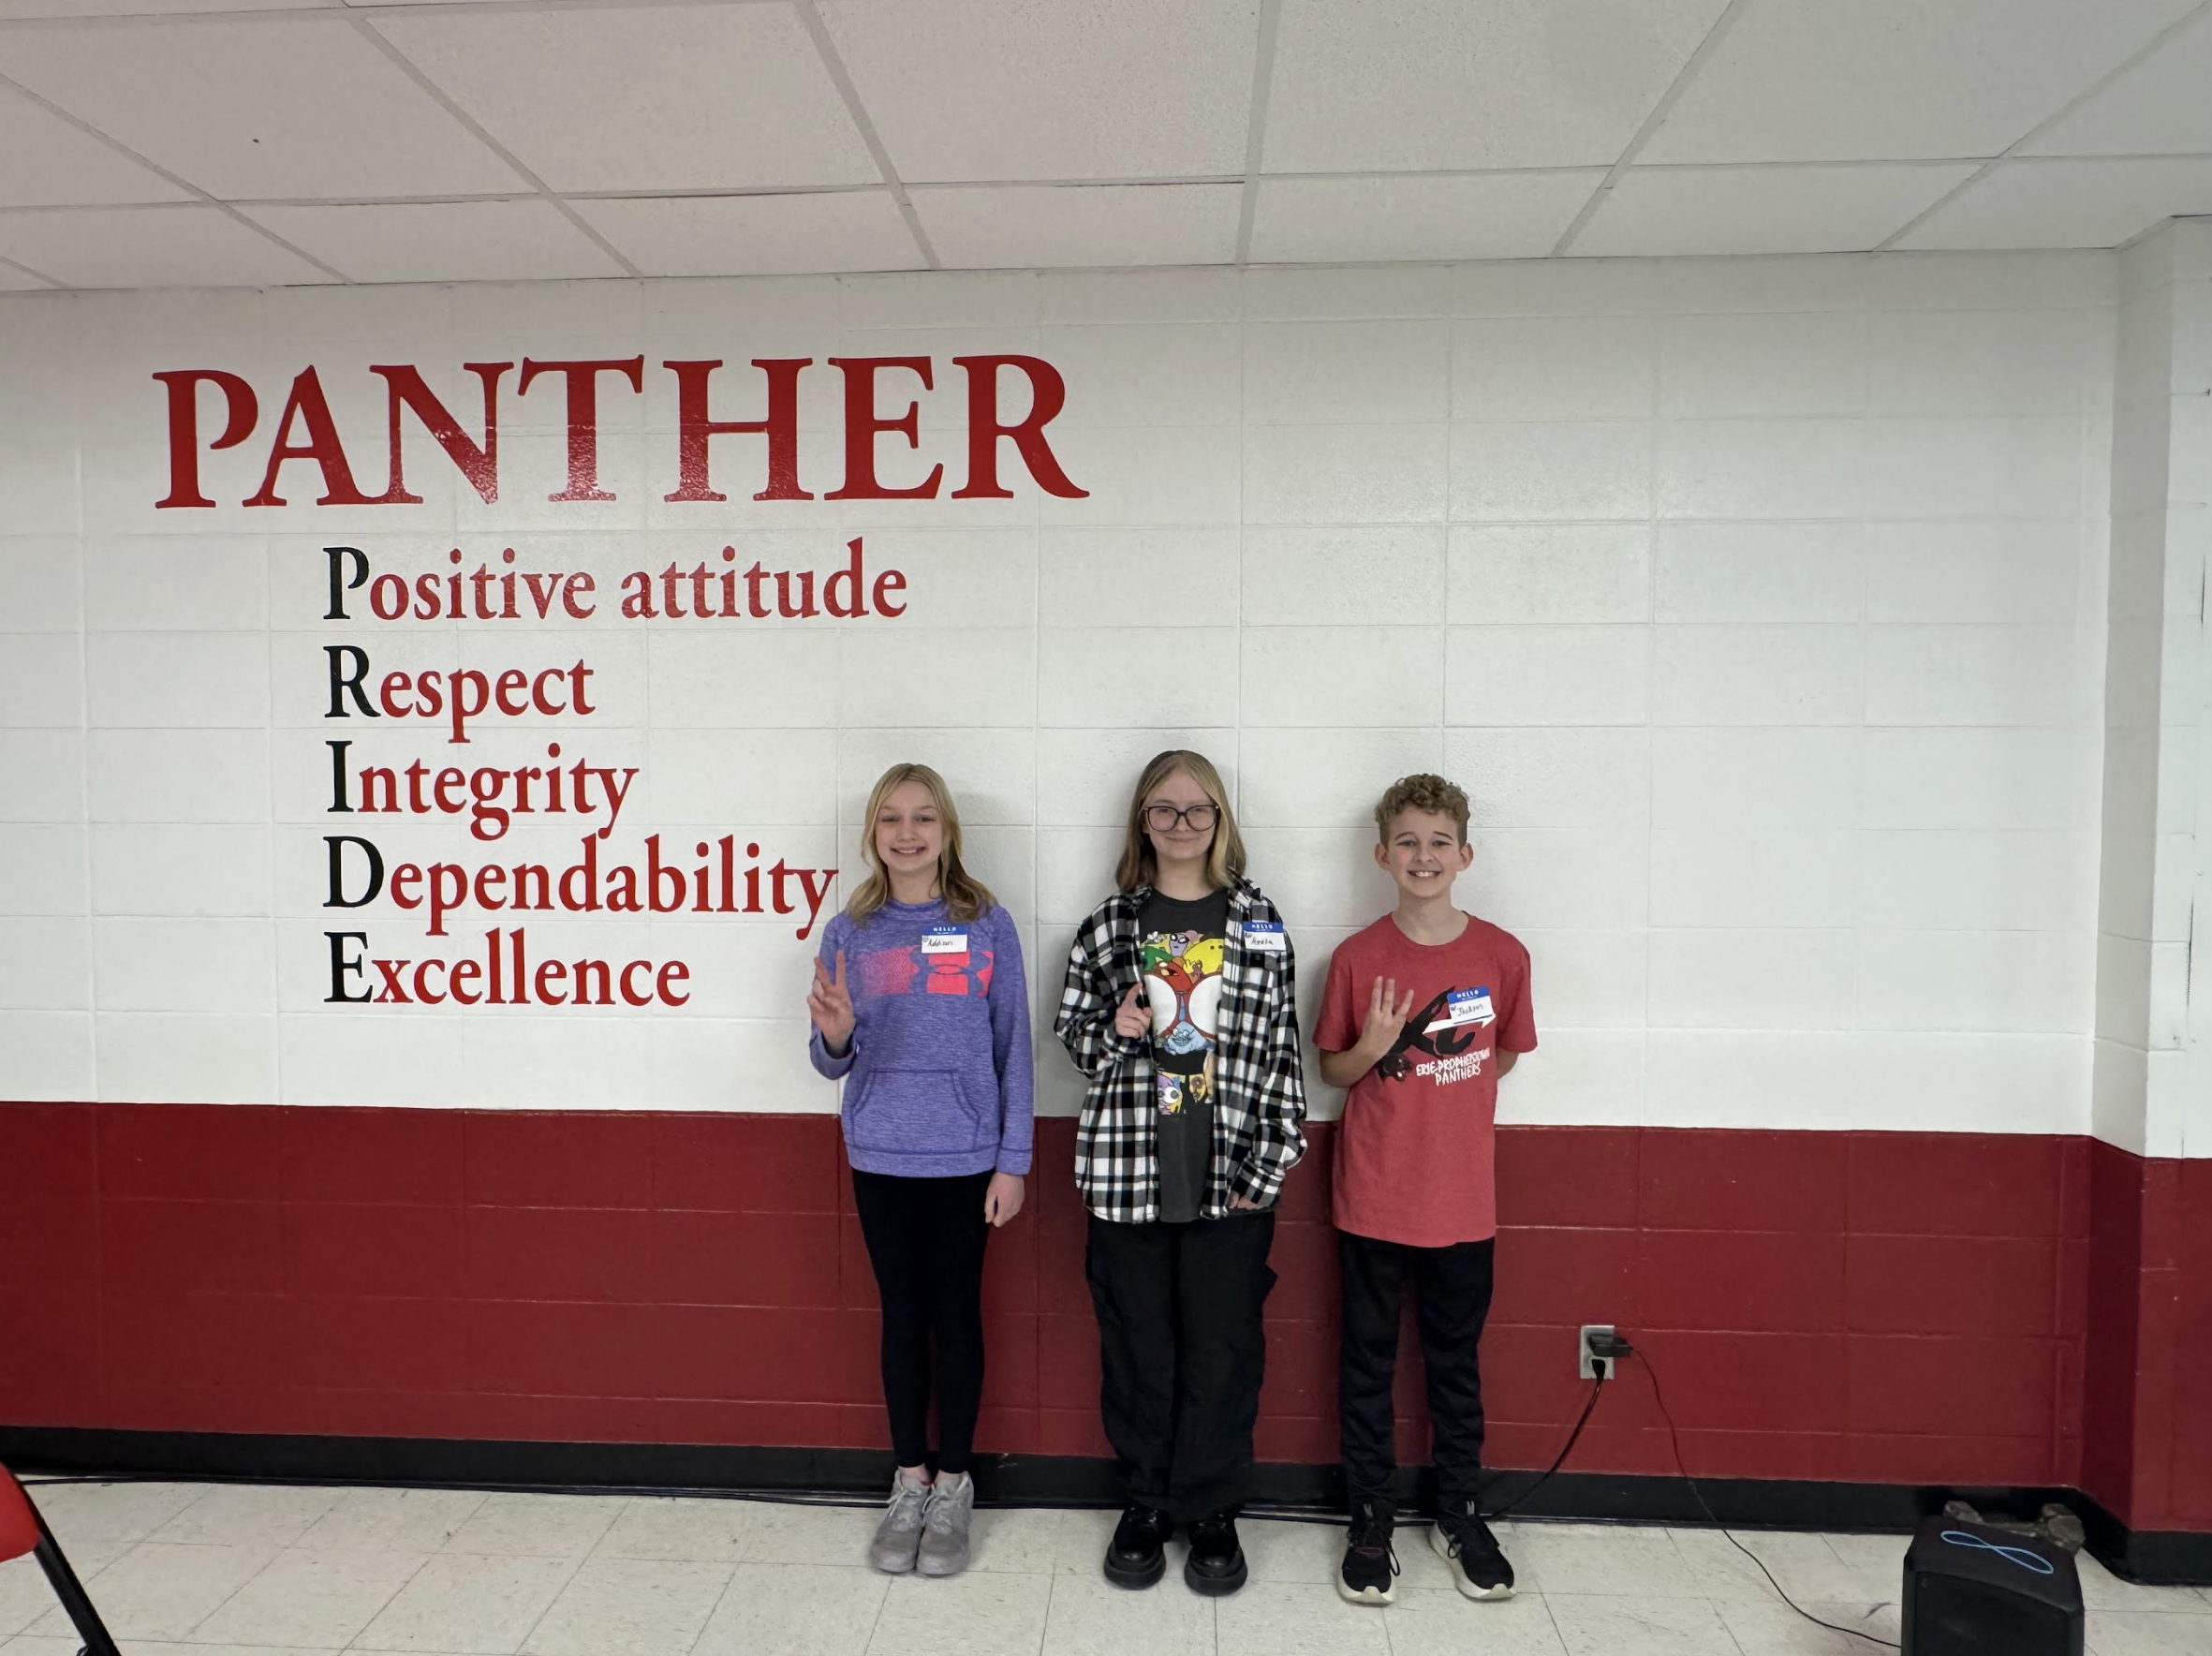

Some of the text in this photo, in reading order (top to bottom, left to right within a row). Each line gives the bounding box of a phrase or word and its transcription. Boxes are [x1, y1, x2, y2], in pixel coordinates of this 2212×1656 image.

[154, 354, 1089, 509] PANTHER
[322, 537, 907, 621] Positive attitude
[323, 645, 595, 744] Respect
[325, 740, 640, 841] Integrity
[322, 834, 838, 940] Dependability
[323, 928, 690, 1007] Excellence
